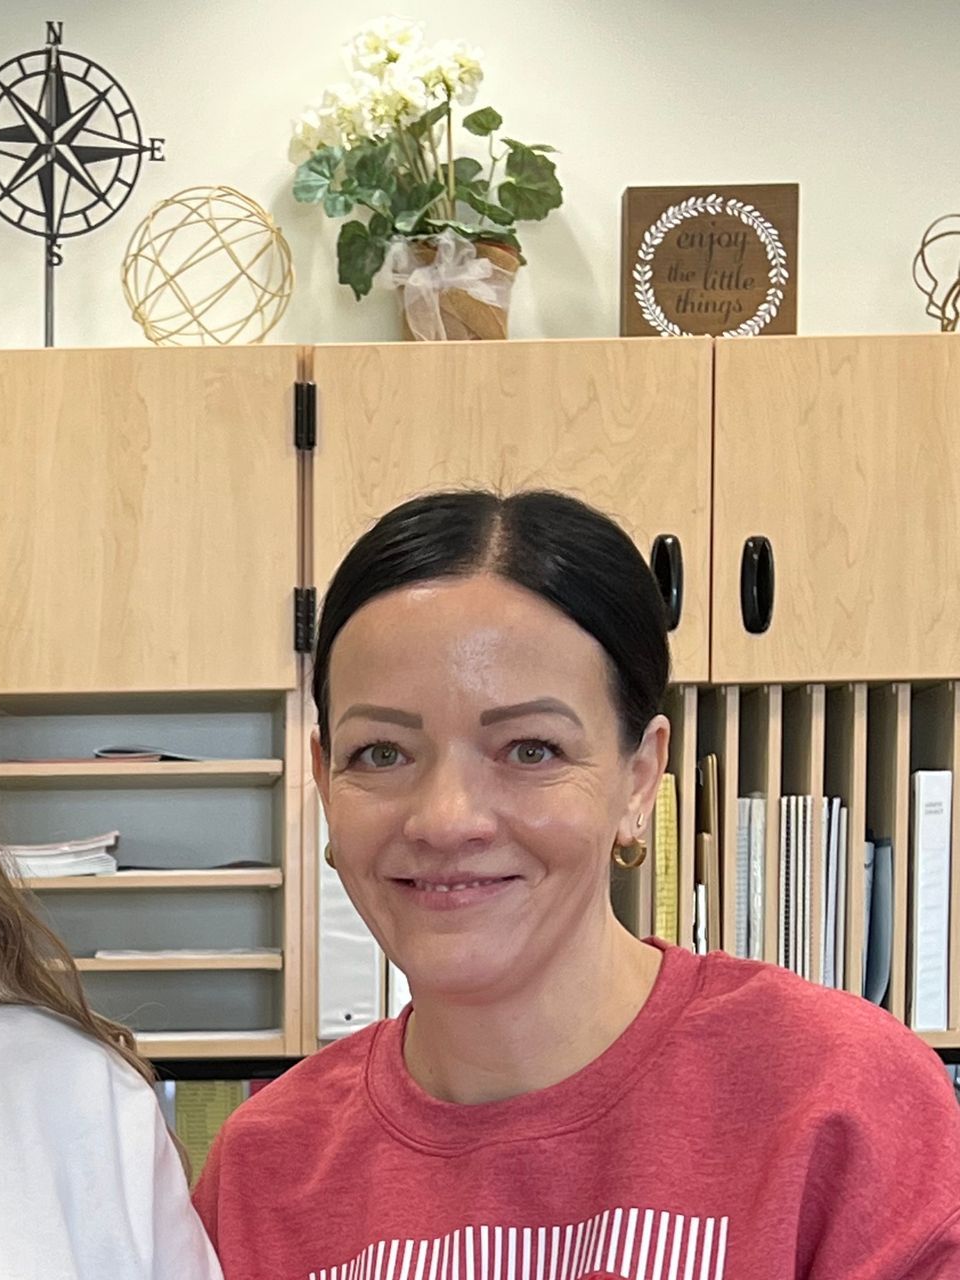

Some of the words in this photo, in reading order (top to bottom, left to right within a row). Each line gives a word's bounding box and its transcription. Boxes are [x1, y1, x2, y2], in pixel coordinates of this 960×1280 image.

[46, 21, 64, 45] N
[148, 138, 166, 162] E
[48, 243, 64, 266] S
[676, 221, 748, 263] enjoy
[667, 262, 696, 284] the
[703, 264, 755, 292] little
[675, 289, 743, 325] things
